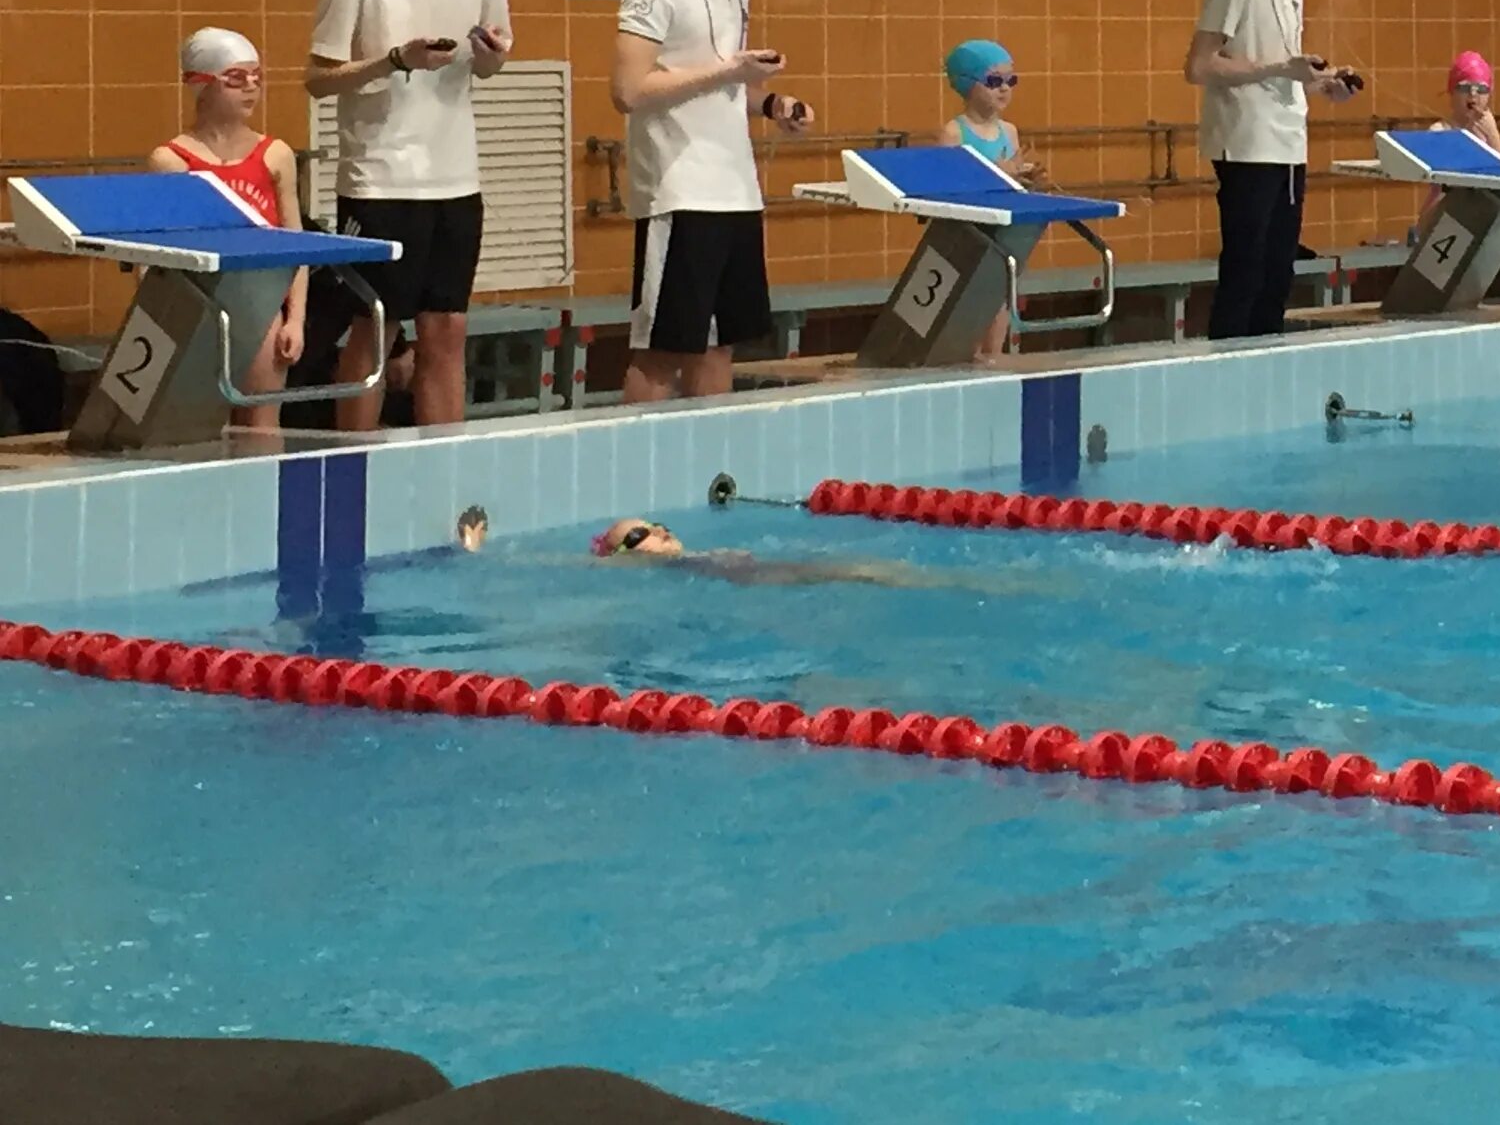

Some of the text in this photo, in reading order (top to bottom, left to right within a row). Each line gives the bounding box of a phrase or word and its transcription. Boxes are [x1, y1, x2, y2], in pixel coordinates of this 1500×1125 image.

[1431, 234, 1458, 265] 4
[913, 268, 943, 308] 3
[116, 336, 153, 394] 2
